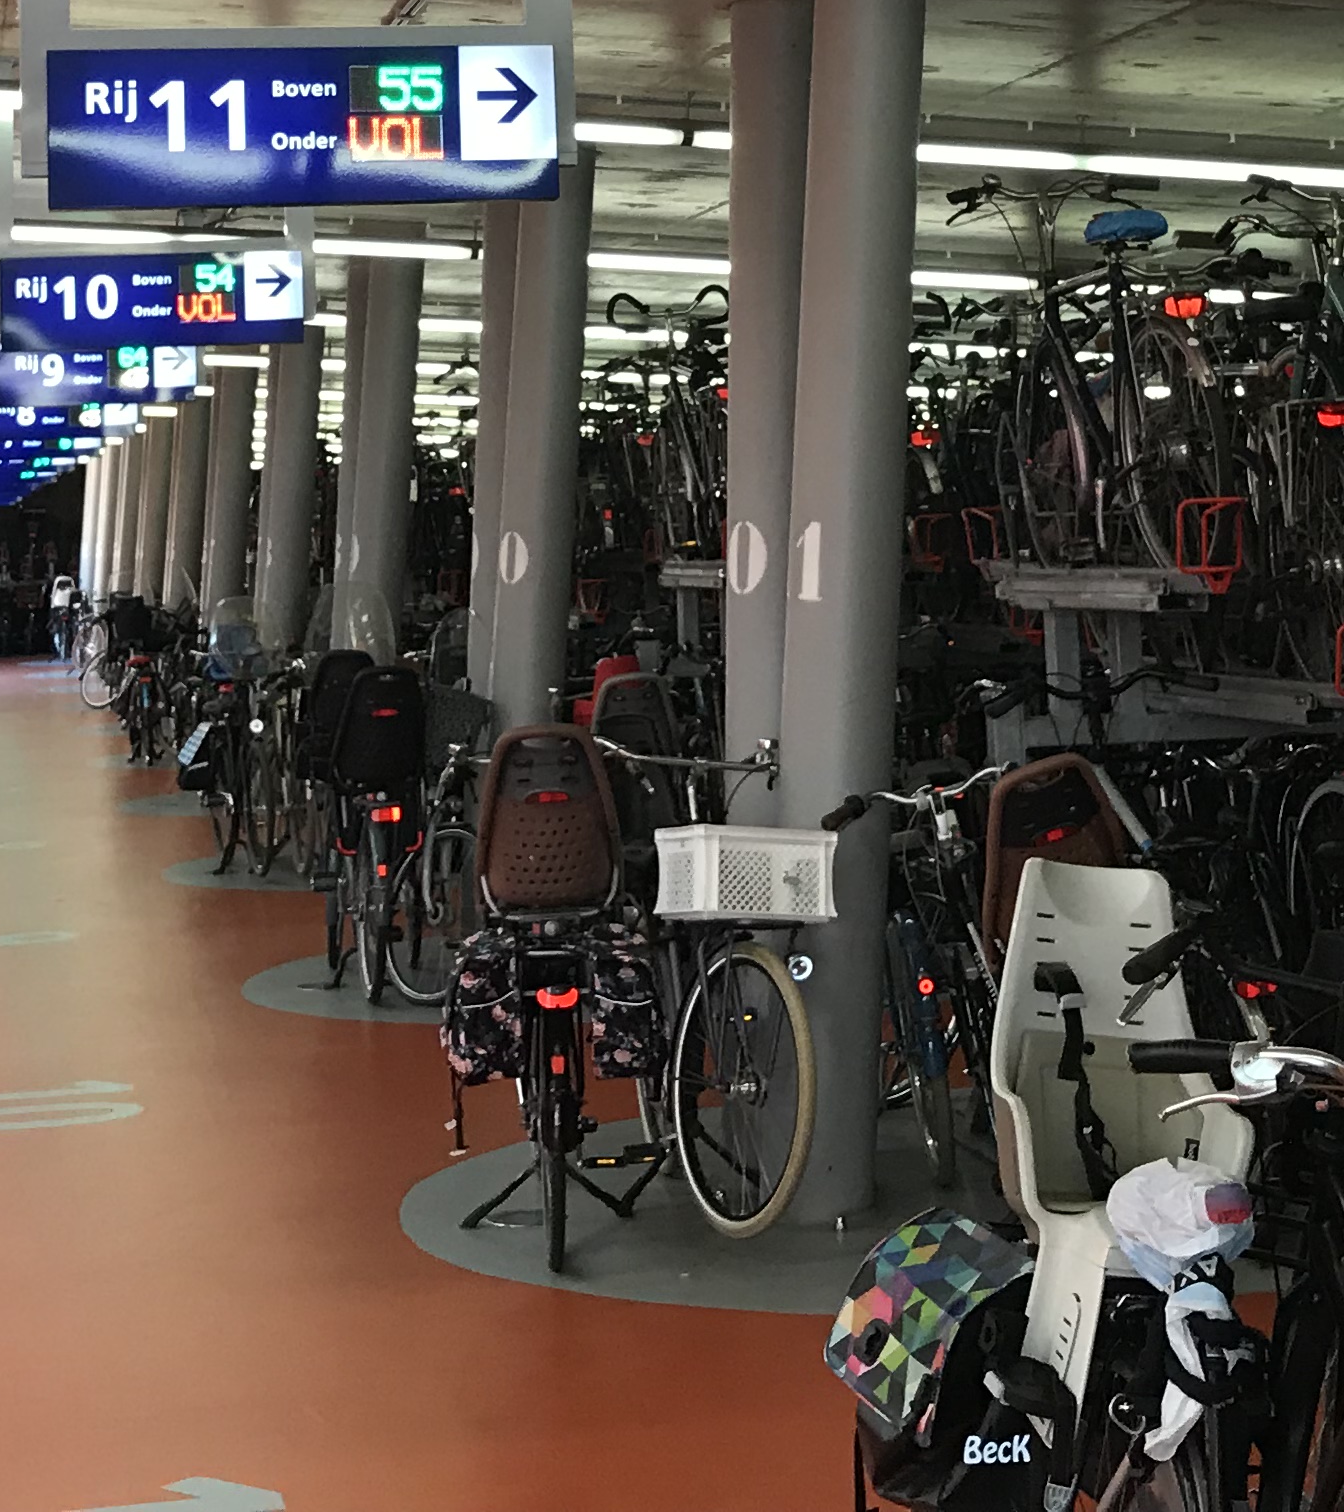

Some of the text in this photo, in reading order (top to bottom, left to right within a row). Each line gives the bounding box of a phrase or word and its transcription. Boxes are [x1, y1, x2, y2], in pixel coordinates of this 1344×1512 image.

[271, 79, 337, 98] Boven
[377, 65, 444, 111] 55
[85, 79, 247, 153] Rij 11
[271, 131, 338, 151] Onder
[348, 115, 444, 161] VOL
[132, 273, 173, 287] Boven
[194, 263, 237, 292] 54
[15, 274, 119, 321] Rij 10
[131, 305, 173, 318] Onder
[176, 293, 237, 323] VOL
[14, 353, 65, 387] Rij 9
